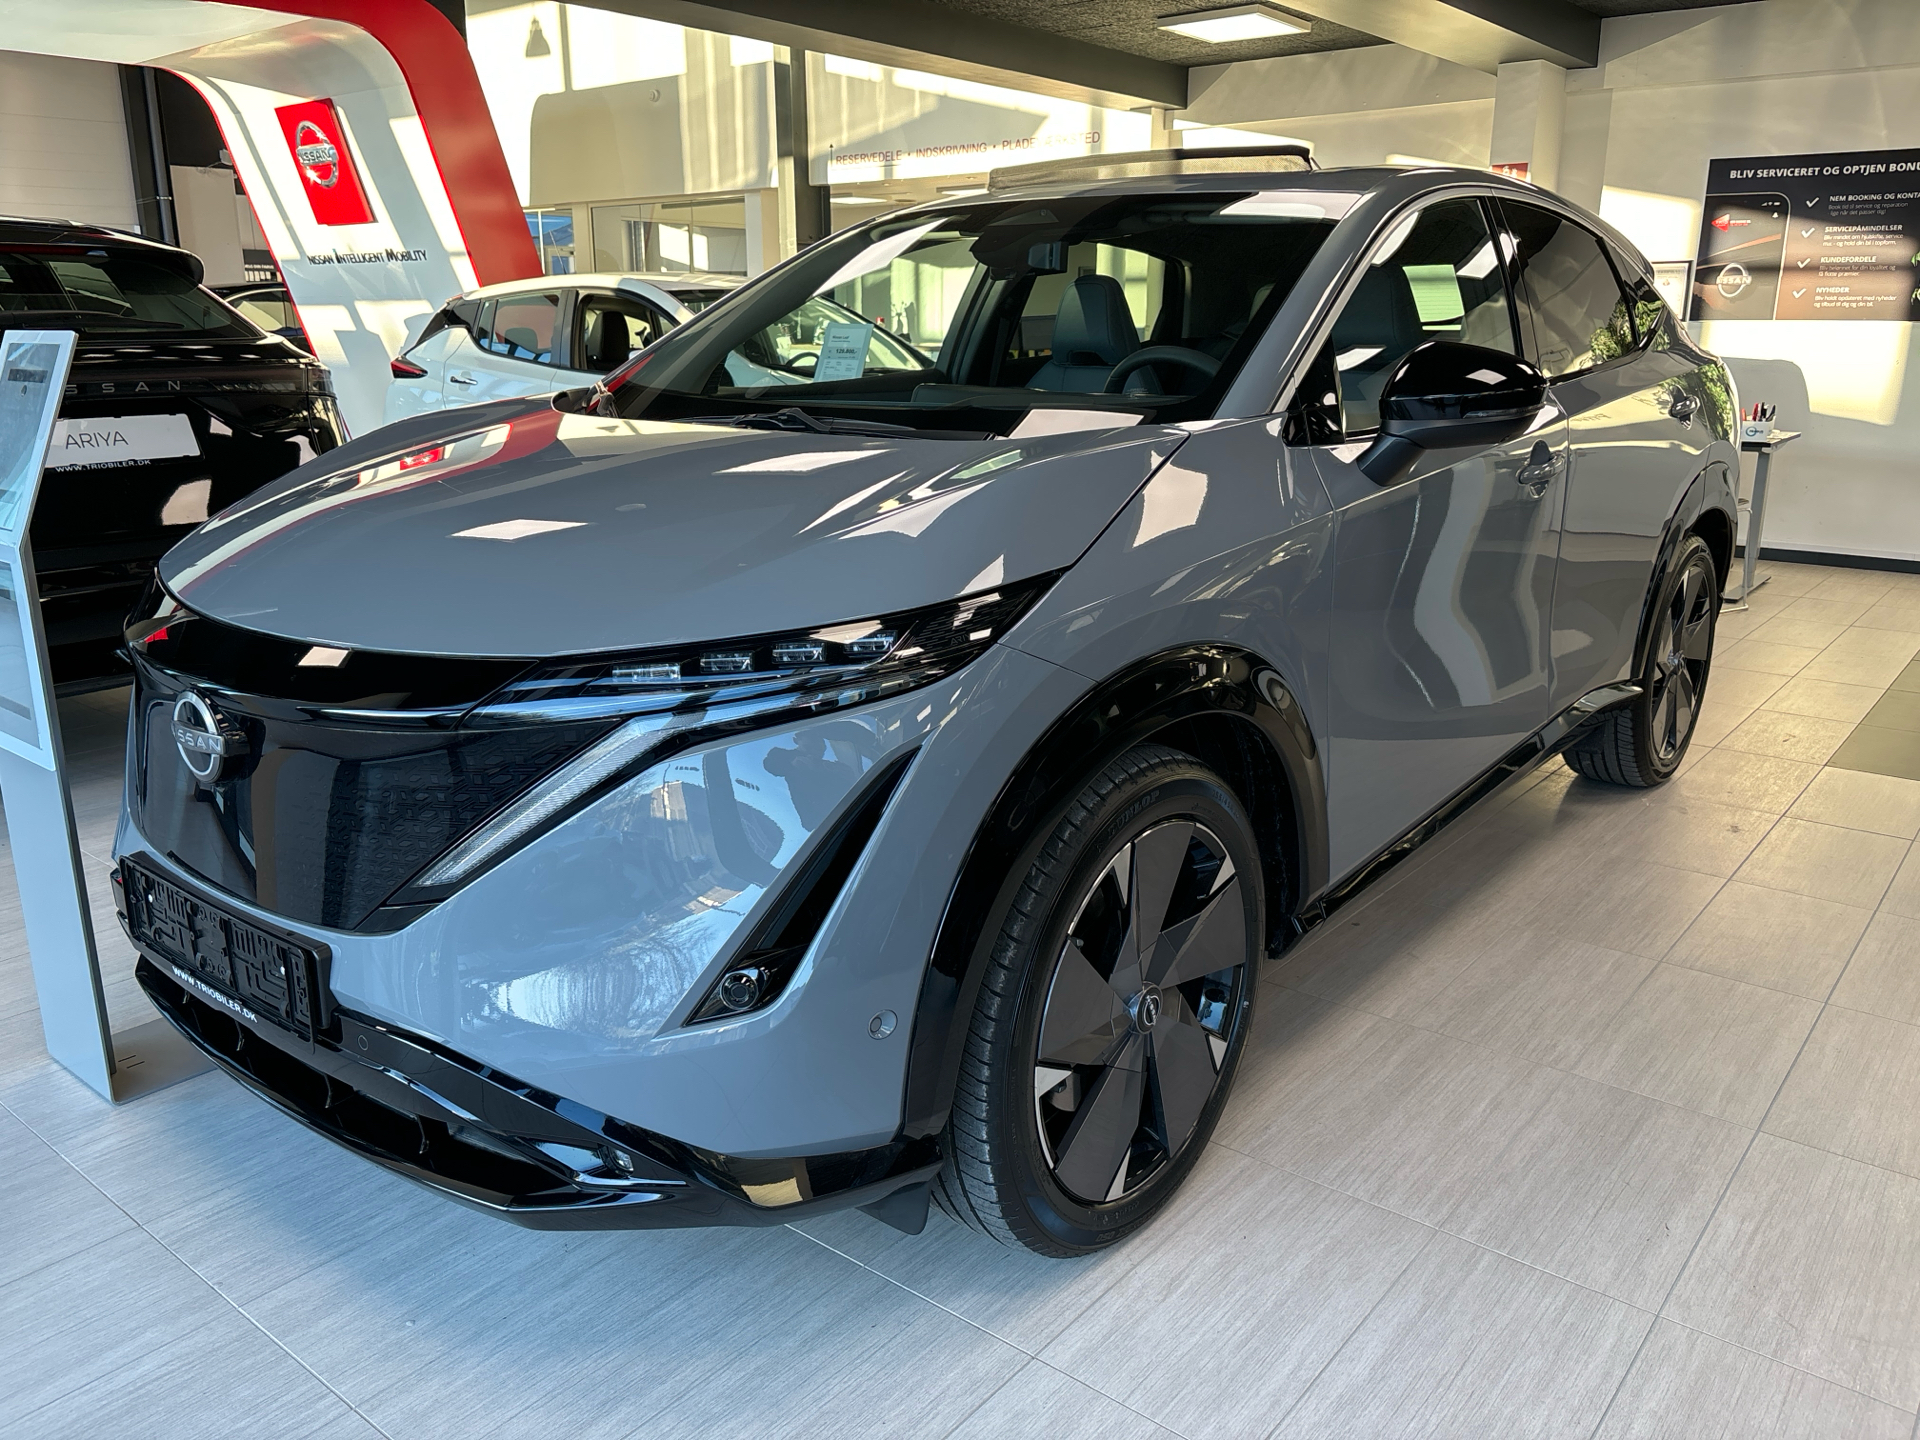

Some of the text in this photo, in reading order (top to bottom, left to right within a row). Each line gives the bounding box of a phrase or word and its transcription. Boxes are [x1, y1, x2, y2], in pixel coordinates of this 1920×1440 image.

[300, 147, 331, 162] ISSAN
[836, 132, 1100, 166] RESERVEDELE INDSKRIVNING PLADEÆRKSTED
[1730, 170, 1754, 179] BLIV
[1756, 167, 1820, 178] SERVICERET
[1822, 166, 1840, 175] OG
[1843, 164, 1886, 176] OPTJEN
[307, 248, 428, 265] NISSAN INTELLIGENT MOBILITY
[65, 381, 180, 394] SSAN
[66, 431, 128, 449] ARIYA
[55, 460, 151, 472] WWW.TRIOBILER.DK
[1108, 790, 1160, 838] DUNLOP
[172, 965, 258, 1023] WWW.TRIOBILER.DK
